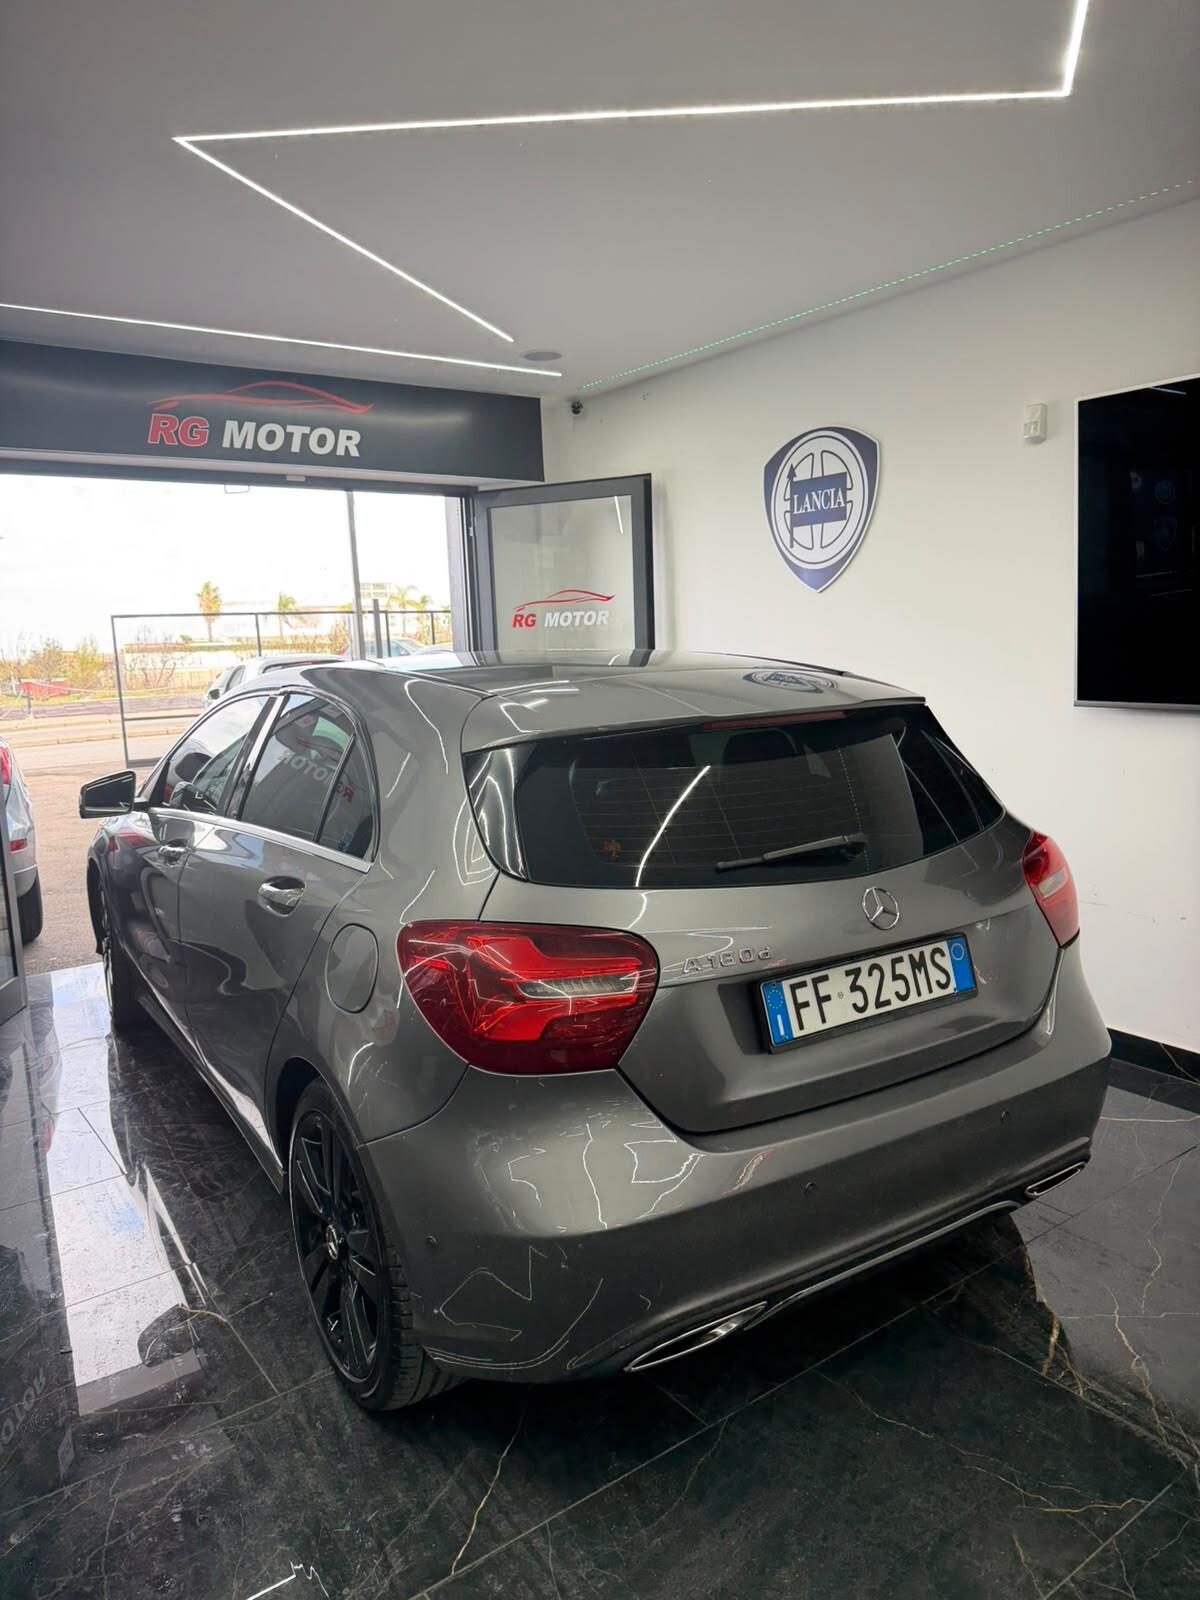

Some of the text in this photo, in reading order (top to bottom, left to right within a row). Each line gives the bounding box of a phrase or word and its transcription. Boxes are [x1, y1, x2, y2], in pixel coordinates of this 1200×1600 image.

[147, 413, 361, 457] RG MOTOR
[793, 487, 845, 514] LANCIA
[512, 610, 609, 628] RG MOTOR
[789, 946, 951, 1031] FF 325MS
